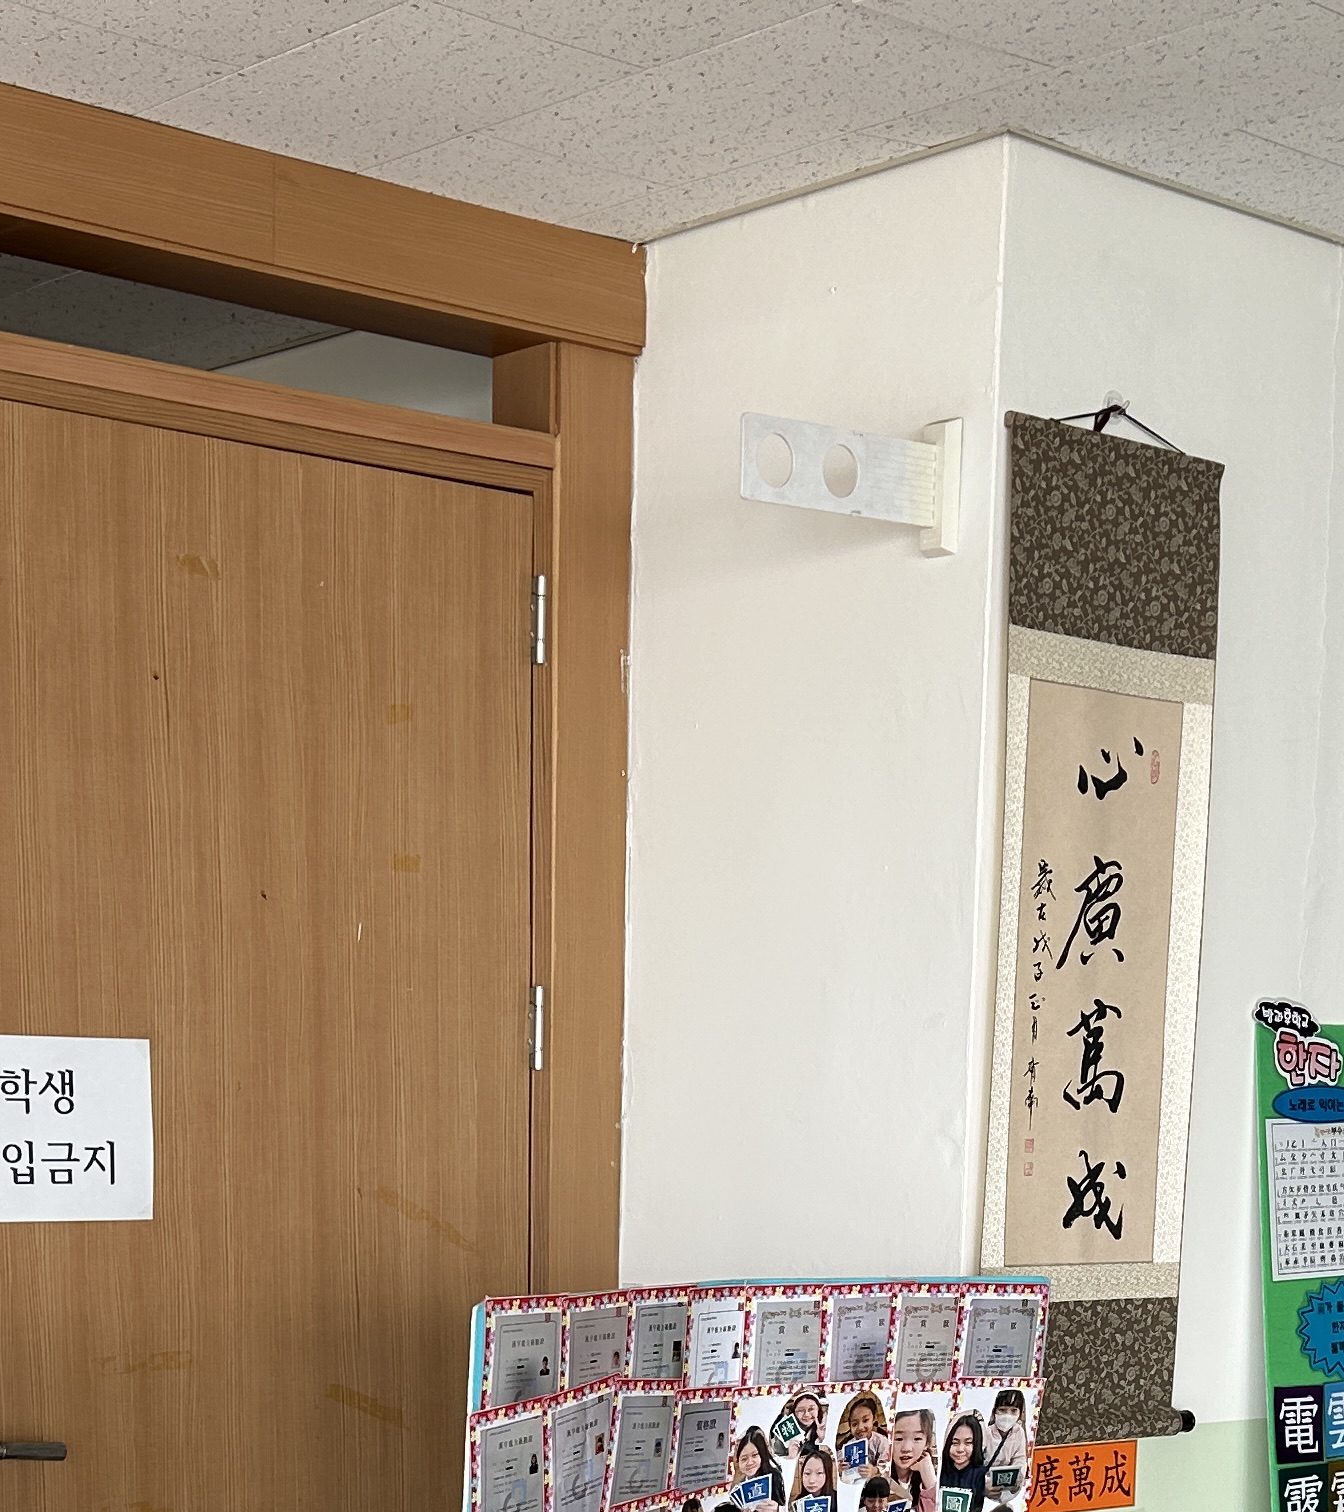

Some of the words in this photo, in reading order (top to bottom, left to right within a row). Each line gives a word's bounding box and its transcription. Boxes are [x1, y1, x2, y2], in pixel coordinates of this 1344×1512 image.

[1262, 1006, 1309, 1029] 방과후학교
[1277, 1031, 1341, 1086] 한자
[1289, 1099, 1315, 1112] 노래로
[1278, 1395, 1319, 1454] 電
[1033, 1450, 1131, 1507] 廣萬成
